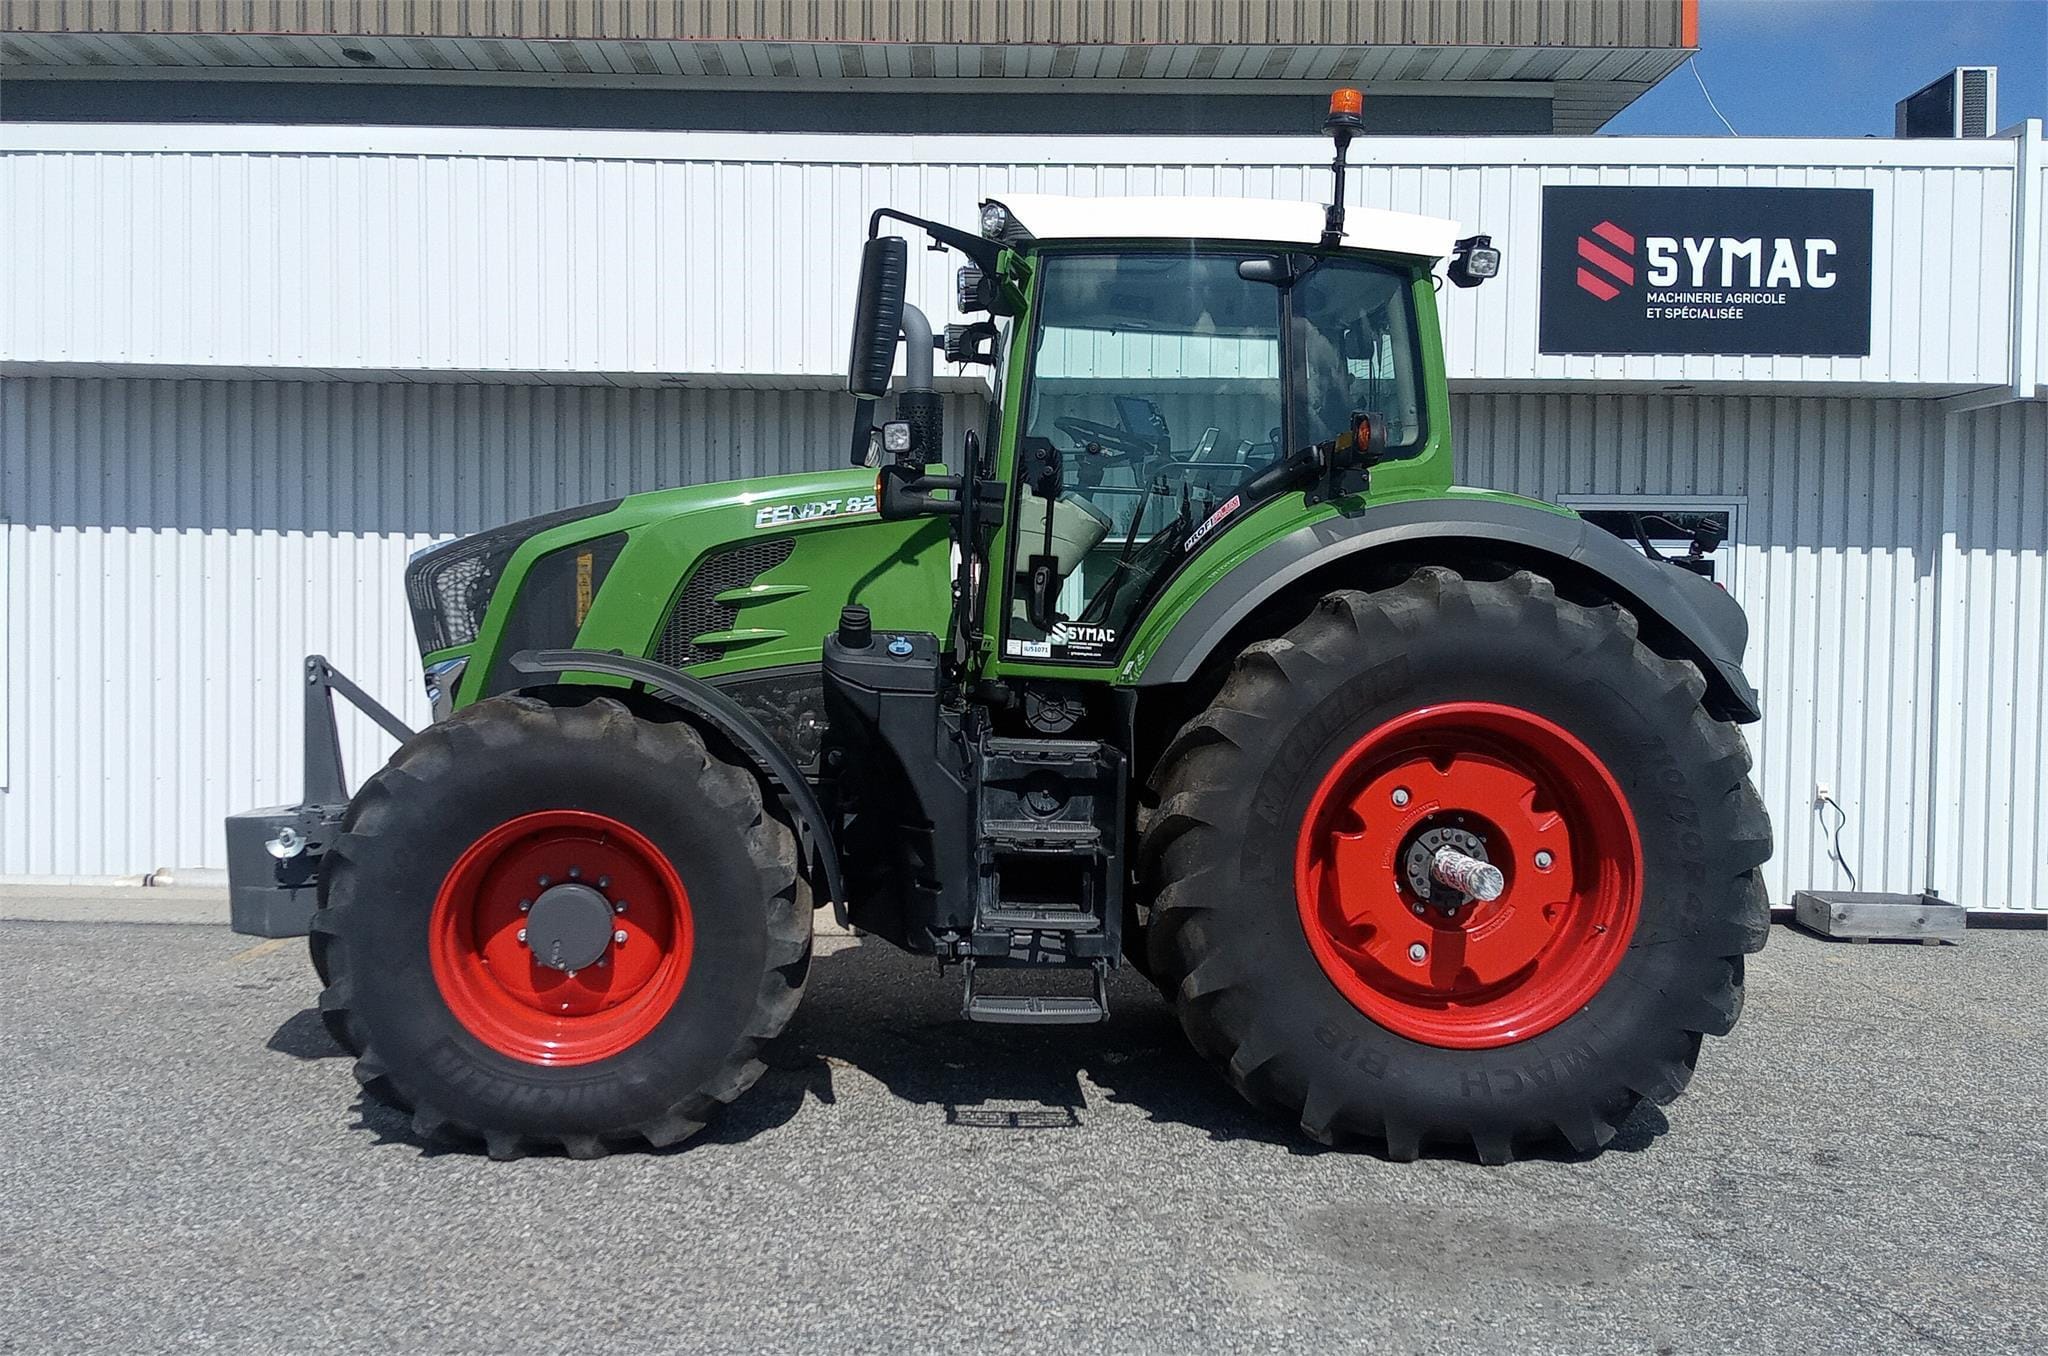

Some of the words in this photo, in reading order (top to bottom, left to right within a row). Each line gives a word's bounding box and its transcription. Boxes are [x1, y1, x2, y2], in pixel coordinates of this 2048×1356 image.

[1646, 236, 1838, 289] SYMAC
[1646, 292, 1723, 304] MACHINERIE
[1725, 293, 1787, 305] AGRICOLE
[1646, 308, 1661, 319] ET
[1664, 306, 1744, 320] SPÉCIALISÉE
[756, 499, 842, 526] FENDT
[845, 495, 877, 512] 82
[1068, 627, 1116, 643] SYMAC
